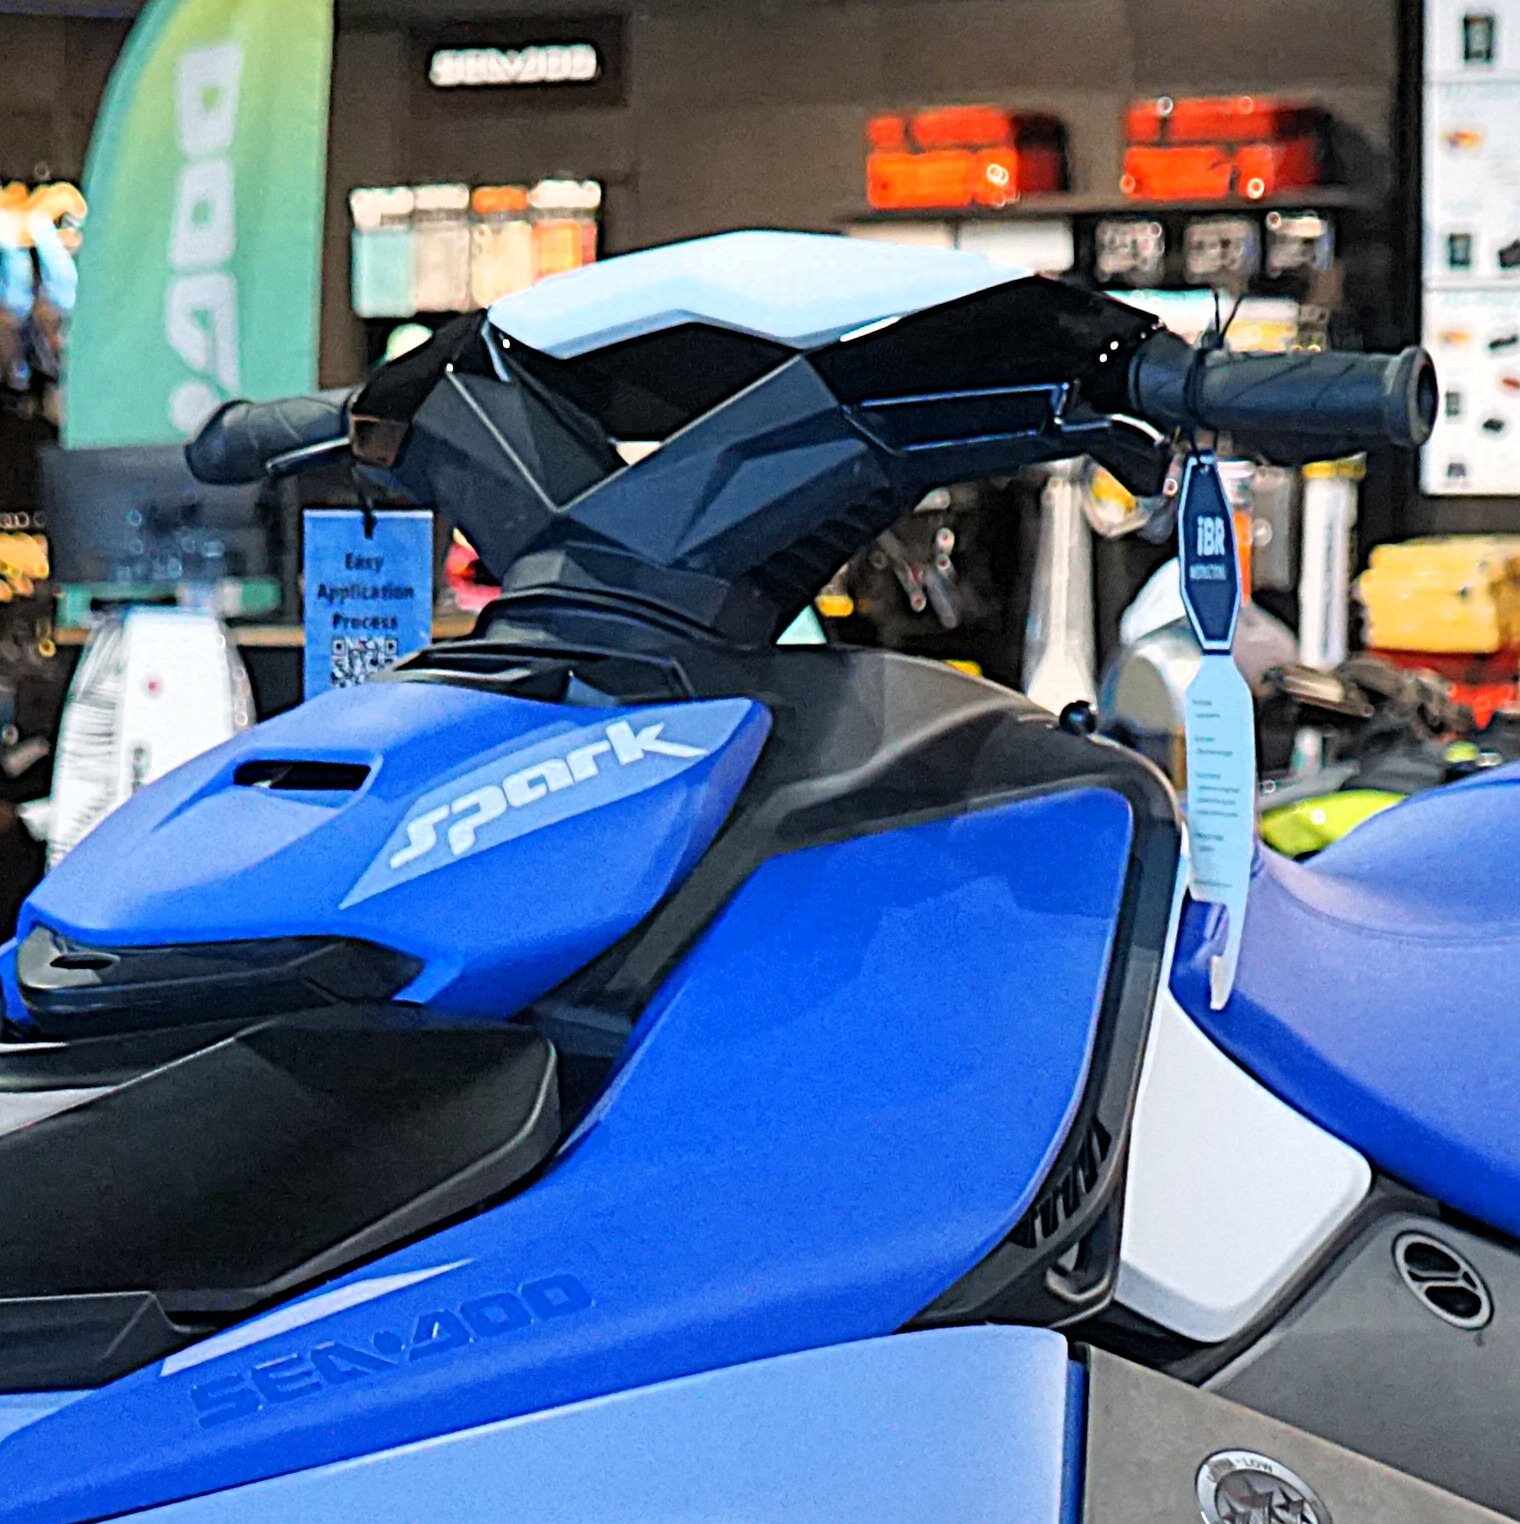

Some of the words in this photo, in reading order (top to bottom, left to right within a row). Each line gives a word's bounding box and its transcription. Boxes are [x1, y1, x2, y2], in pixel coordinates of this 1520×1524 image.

[1197, 515, 1225, 557] iBR
[344, 551, 384, 573] Easy
[317, 583, 414, 605] Application
[332, 613, 399, 630] Process
